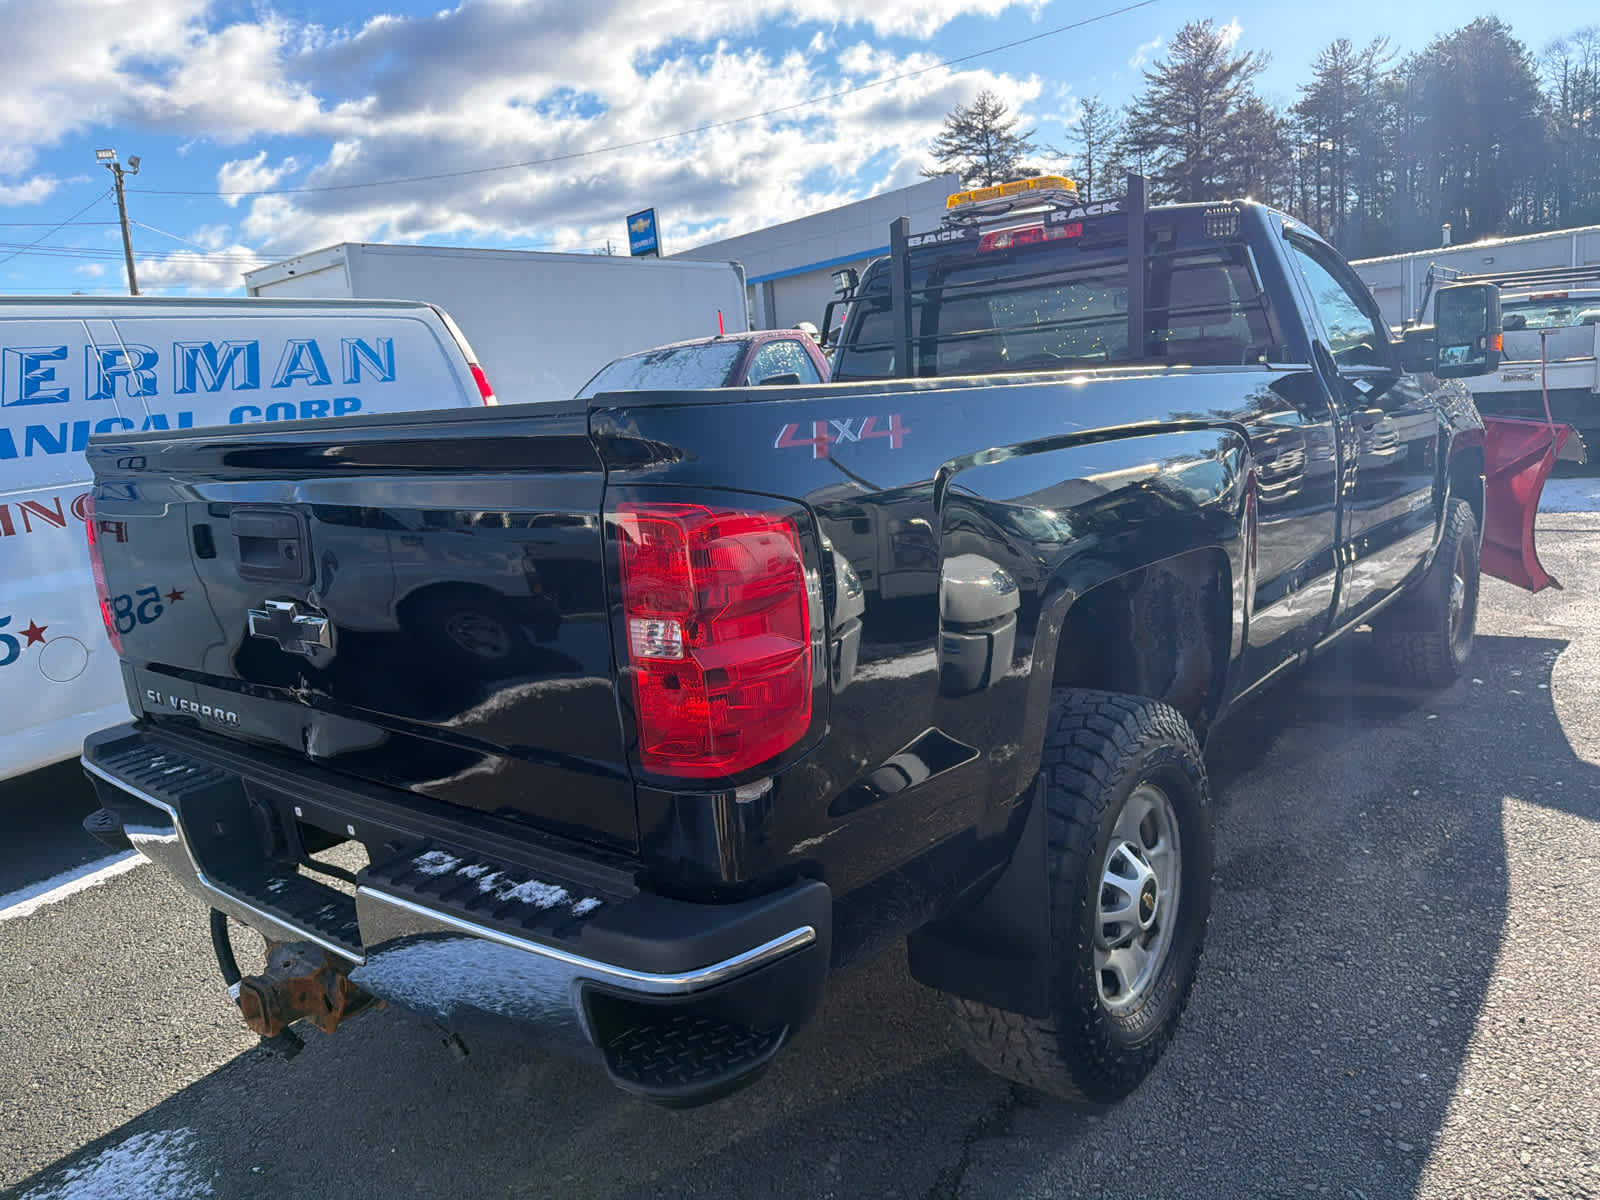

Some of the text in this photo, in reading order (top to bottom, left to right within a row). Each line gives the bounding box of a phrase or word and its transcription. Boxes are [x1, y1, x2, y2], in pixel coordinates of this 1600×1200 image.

[907, 201, 1122, 249] BACK RACK
[2, 335, 396, 406] ERMAN
[229, 396, 377, 425] CORP
[146, 689, 241, 728] SIVERADO
